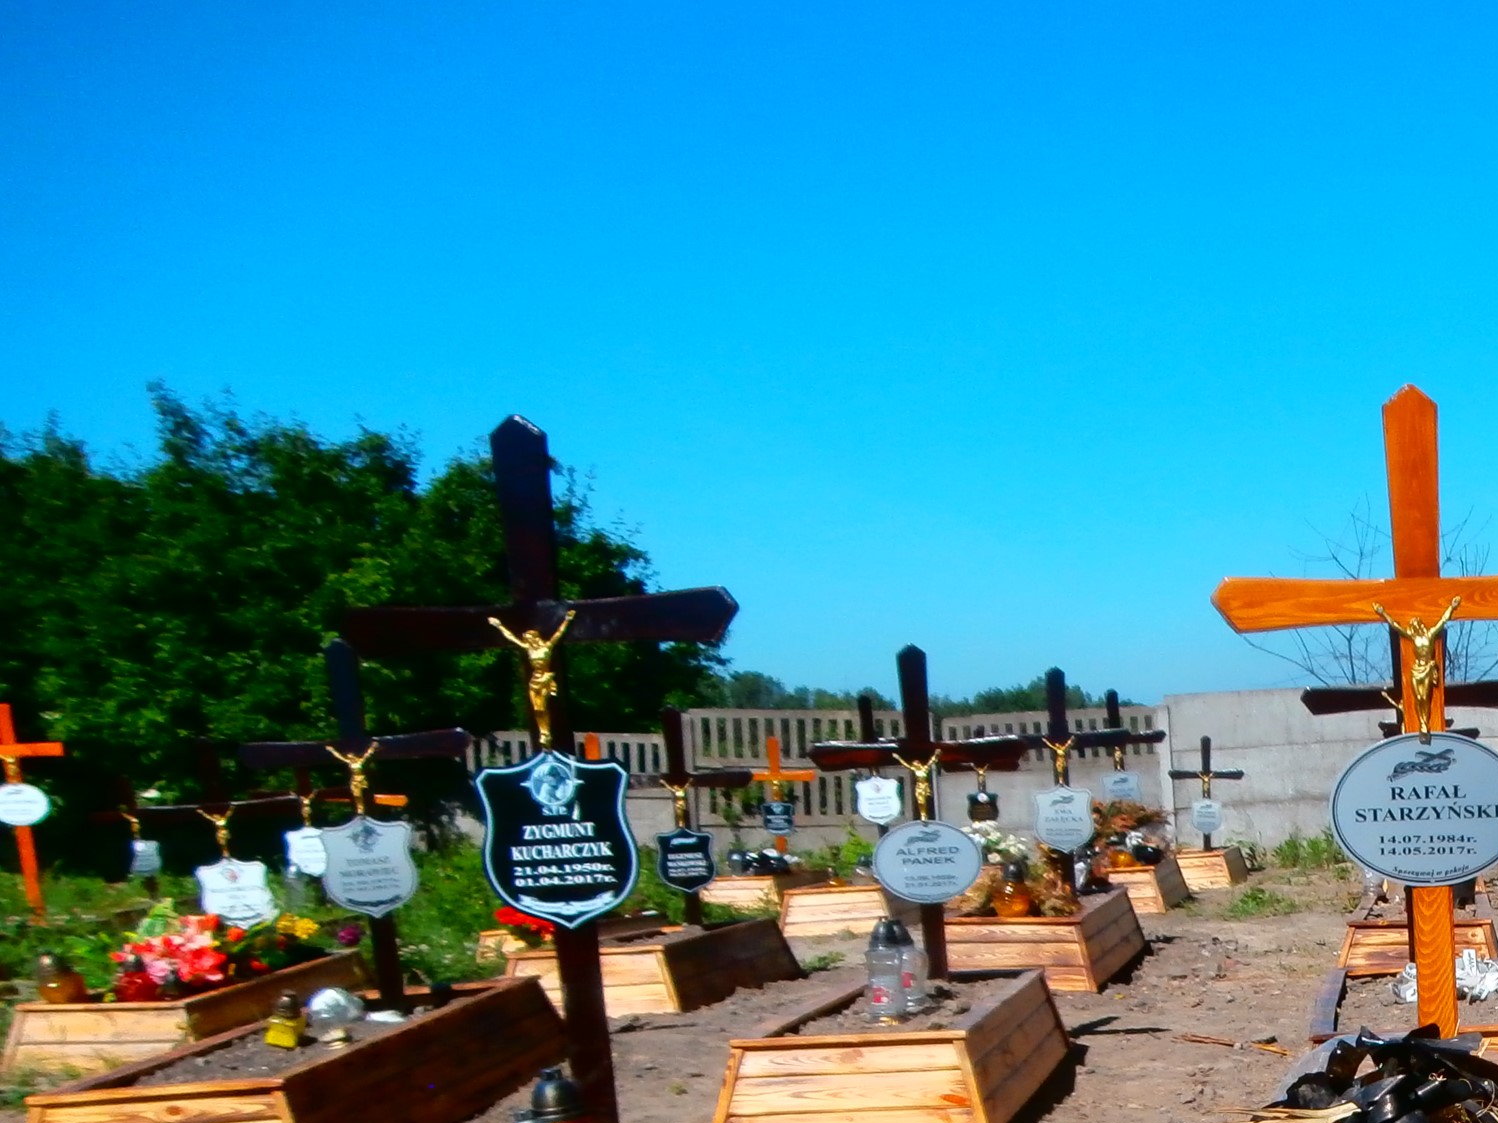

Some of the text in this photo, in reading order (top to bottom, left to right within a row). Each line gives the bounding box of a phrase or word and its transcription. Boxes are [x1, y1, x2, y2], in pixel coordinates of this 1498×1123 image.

[1390, 785, 1467, 800] RAFAŁ
[522, 821, 597, 840] ZYGMUNT
[1379, 834, 1478, 844] 14.07.1984r.
[511, 841, 615, 861] KUCHARCZYK
[896, 846, 960, 856] ALFRED
[1379, 846, 1478, 856] 14.05.2017r.
[902, 856, 956, 865] PANEK
